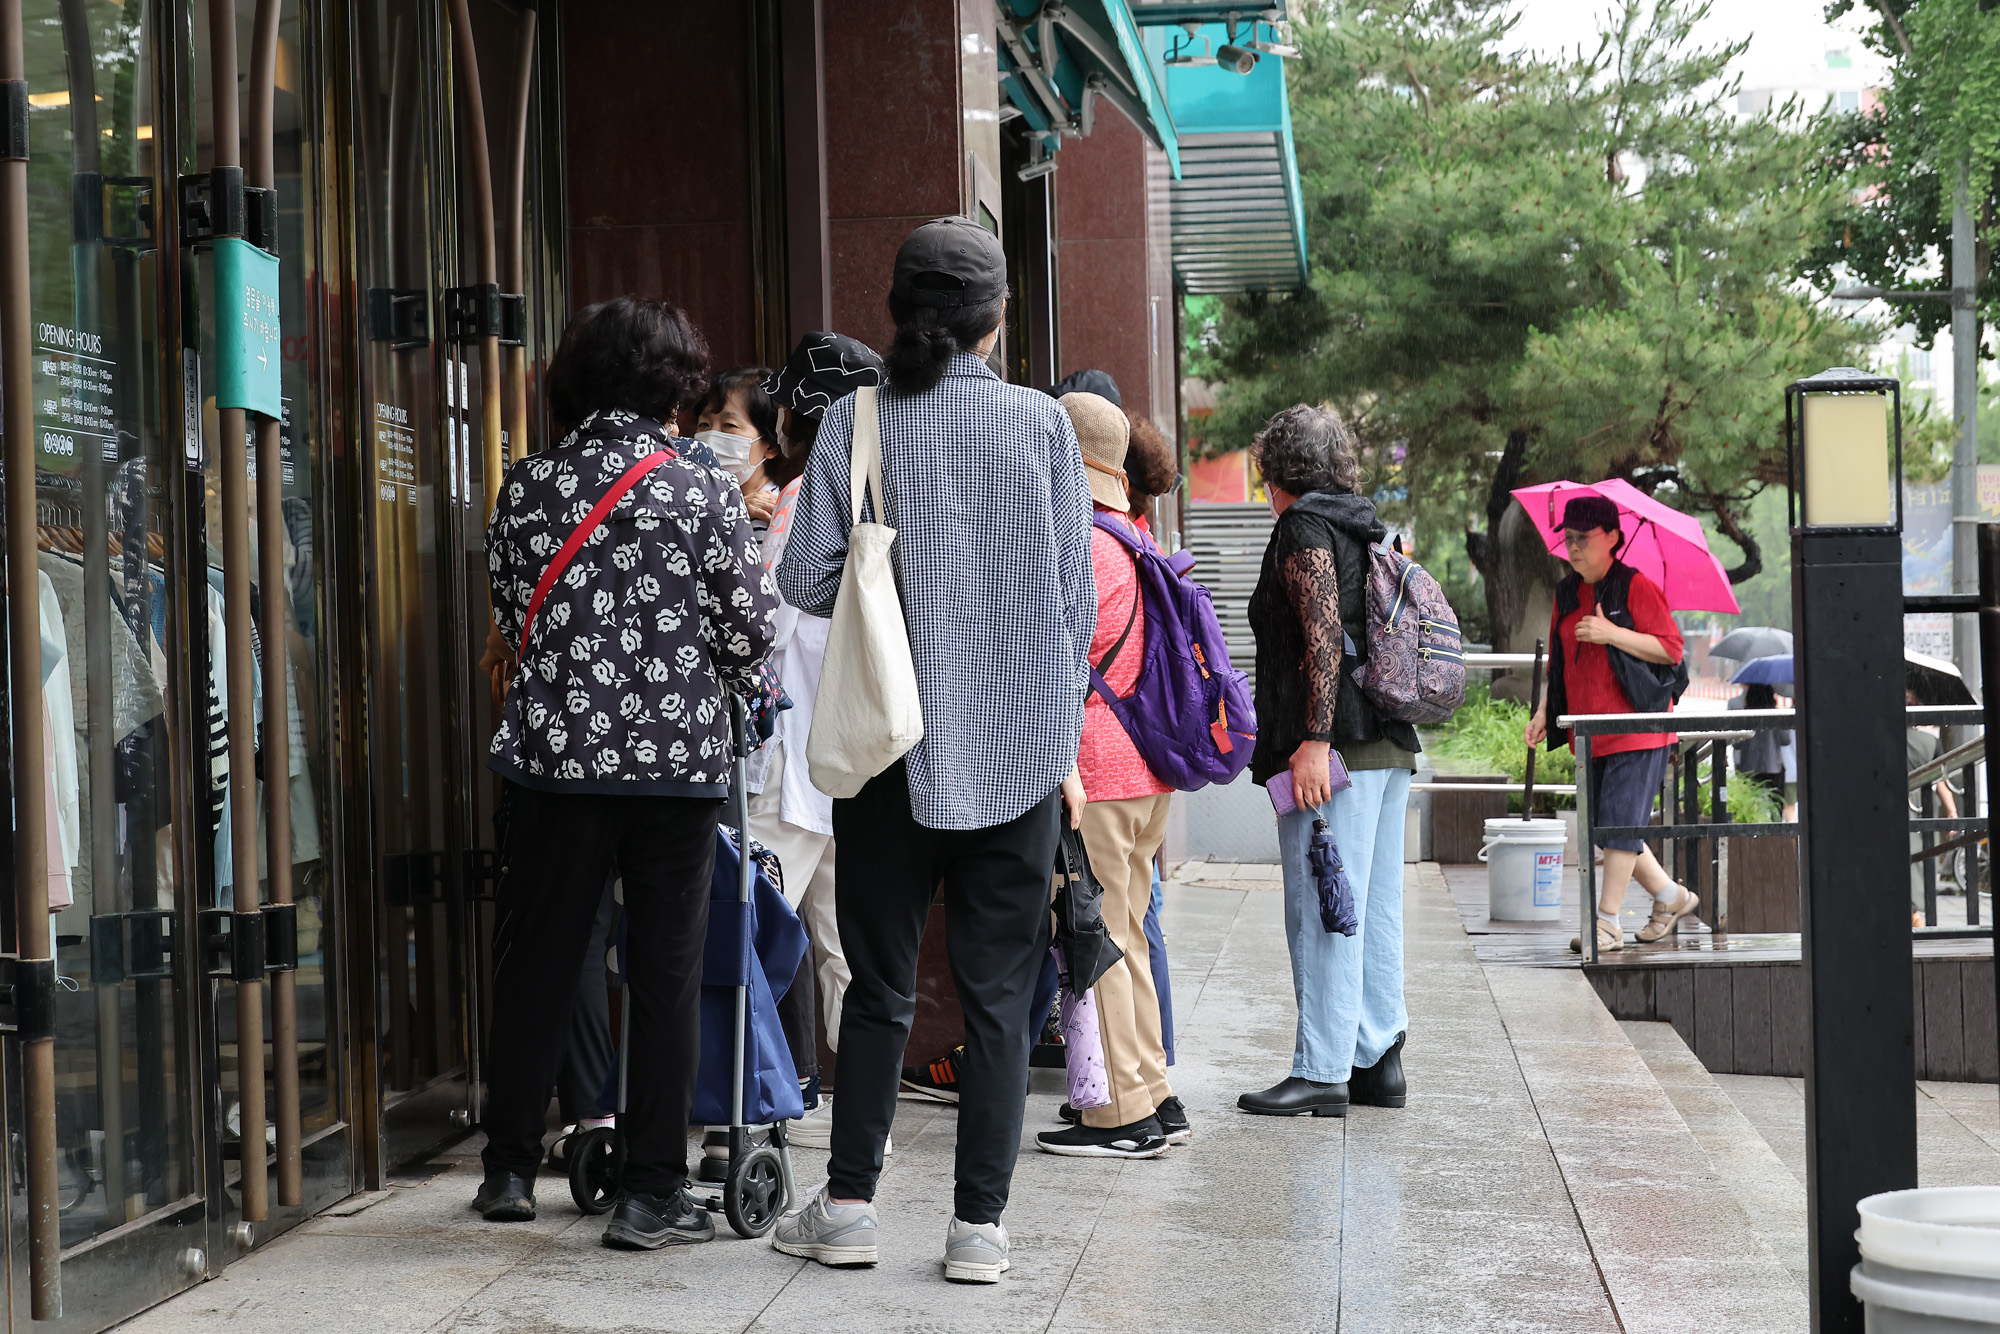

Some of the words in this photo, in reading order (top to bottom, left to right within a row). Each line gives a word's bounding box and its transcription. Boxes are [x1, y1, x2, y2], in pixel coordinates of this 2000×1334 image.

[245, 284, 260, 312] 옆문을
[262, 294, 276, 317] 이용해
[39, 322, 74, 348] OPENING
[76, 330, 102, 354] HOURS
[243, 312, 259, 336] 주시기
[260, 319, 278, 344] 바랍니다
[376, 402, 395, 420] OPENING
[395, 406, 408, 424] HOURS
